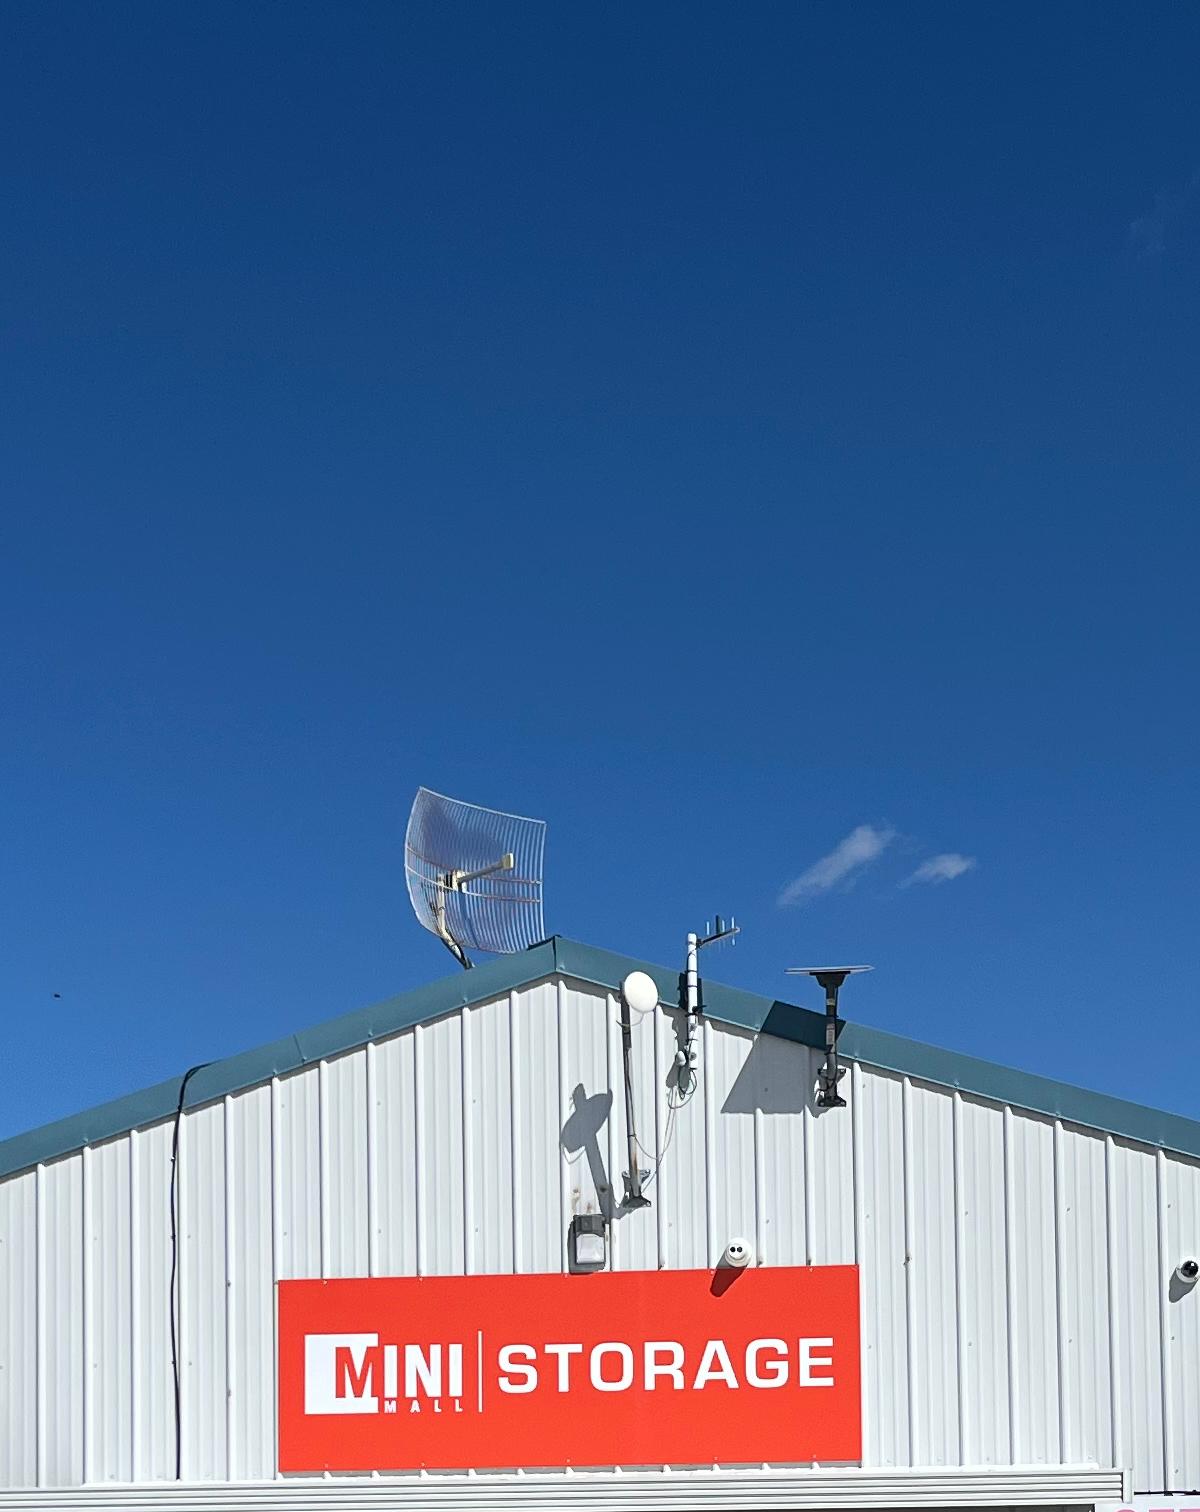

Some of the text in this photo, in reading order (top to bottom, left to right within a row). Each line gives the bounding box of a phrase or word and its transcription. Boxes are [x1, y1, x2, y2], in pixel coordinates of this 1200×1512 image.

[336, 1337, 835, 1399] MINI STORAGE
[384, 1399, 463, 1414] MALL
